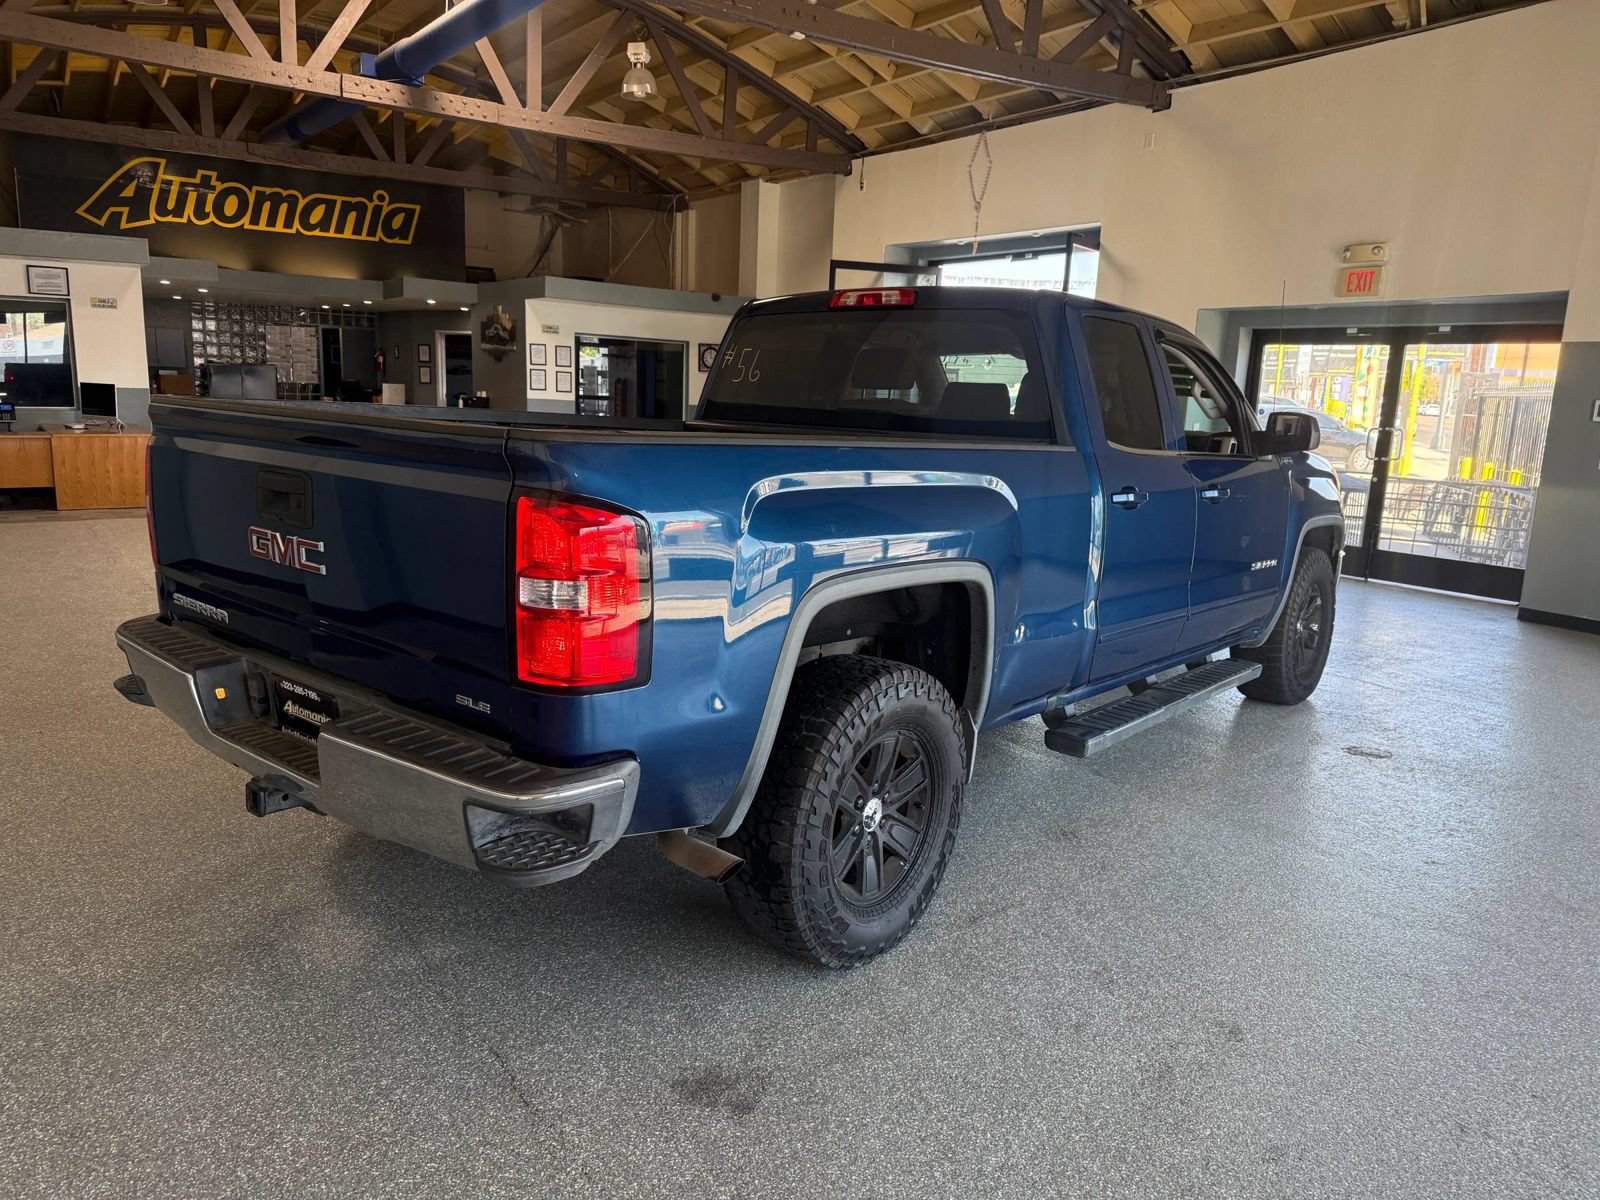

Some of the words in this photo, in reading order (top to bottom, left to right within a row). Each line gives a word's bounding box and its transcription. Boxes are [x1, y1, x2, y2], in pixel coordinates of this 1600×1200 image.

[75, 156, 421, 245] Automania
[1346, 270, 1376, 293] EXIT
[721, 343, 761, 383] #56
[248, 526, 327, 575] GMC
[172, 592, 229, 624] SIERRA
[456, 694, 491, 714] SLE
